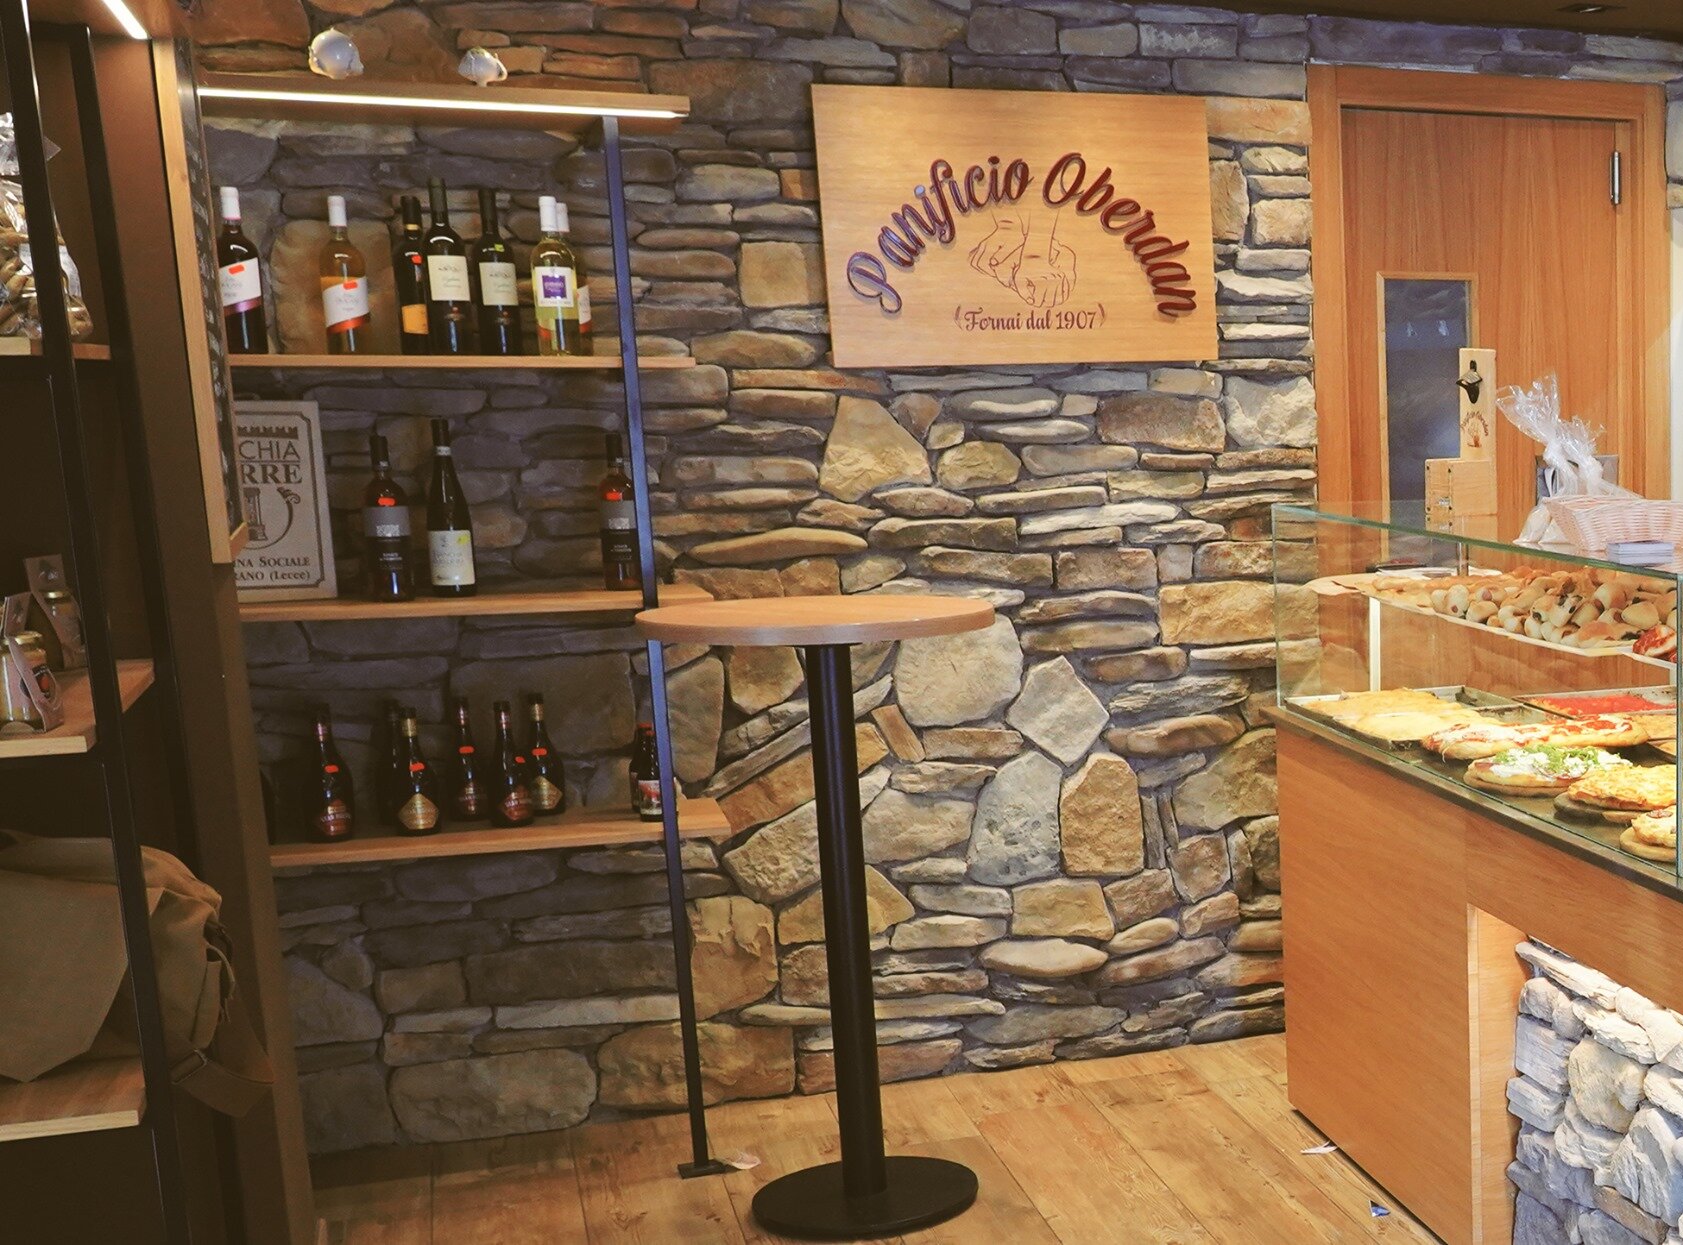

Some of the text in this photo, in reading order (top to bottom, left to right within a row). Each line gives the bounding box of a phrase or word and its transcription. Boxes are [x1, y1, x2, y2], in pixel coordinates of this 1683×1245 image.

[846, 152, 1197, 318] Panificio Oberdan
[1026, 309, 1051, 330] dal
